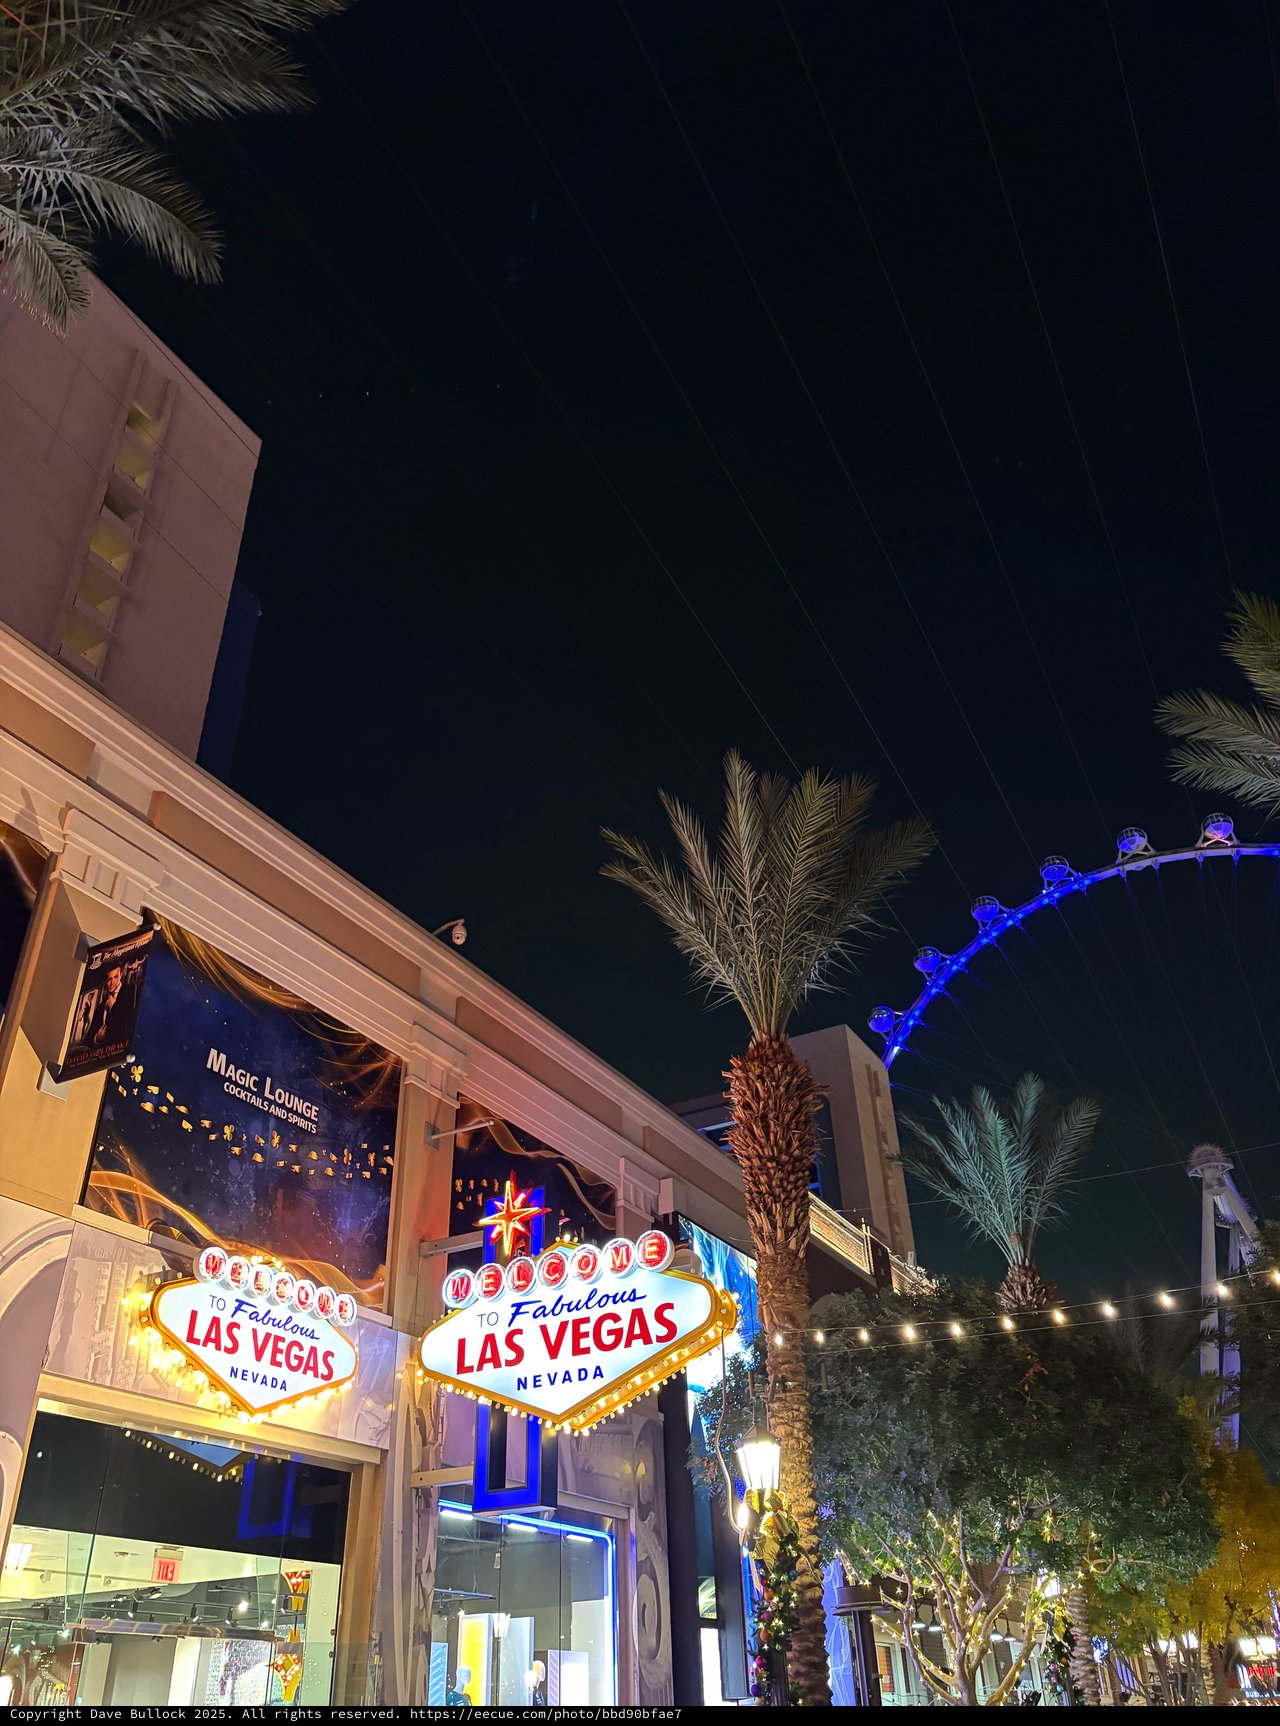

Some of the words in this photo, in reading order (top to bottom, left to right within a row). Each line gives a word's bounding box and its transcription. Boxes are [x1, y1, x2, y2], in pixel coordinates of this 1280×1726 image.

[223, 1081, 269, 1112] COCKTAILS
[269, 1104, 287, 1121] AND
[287, 1112, 318, 1134] SPIRITS
[203, 1251, 352, 1322] WELCOME
[450, 1236, 669, 1301] WELCOME
[209, 1294, 226, 1311] TO
[231, 1298, 320, 1340] Fabulous
[477, 1311, 499, 1328] TO
[508, 1287, 647, 1328] Fabulous
[186, 1309, 241, 1355] LAS
[251, 1328, 335, 1381] VEGAS
[456, 1328, 525, 1375] LAS
[539, 1302, 678, 1360] VEGAS
[229, 1366, 288, 1392] NEVADA
[516, 1365, 605, 1391] NEVADA
